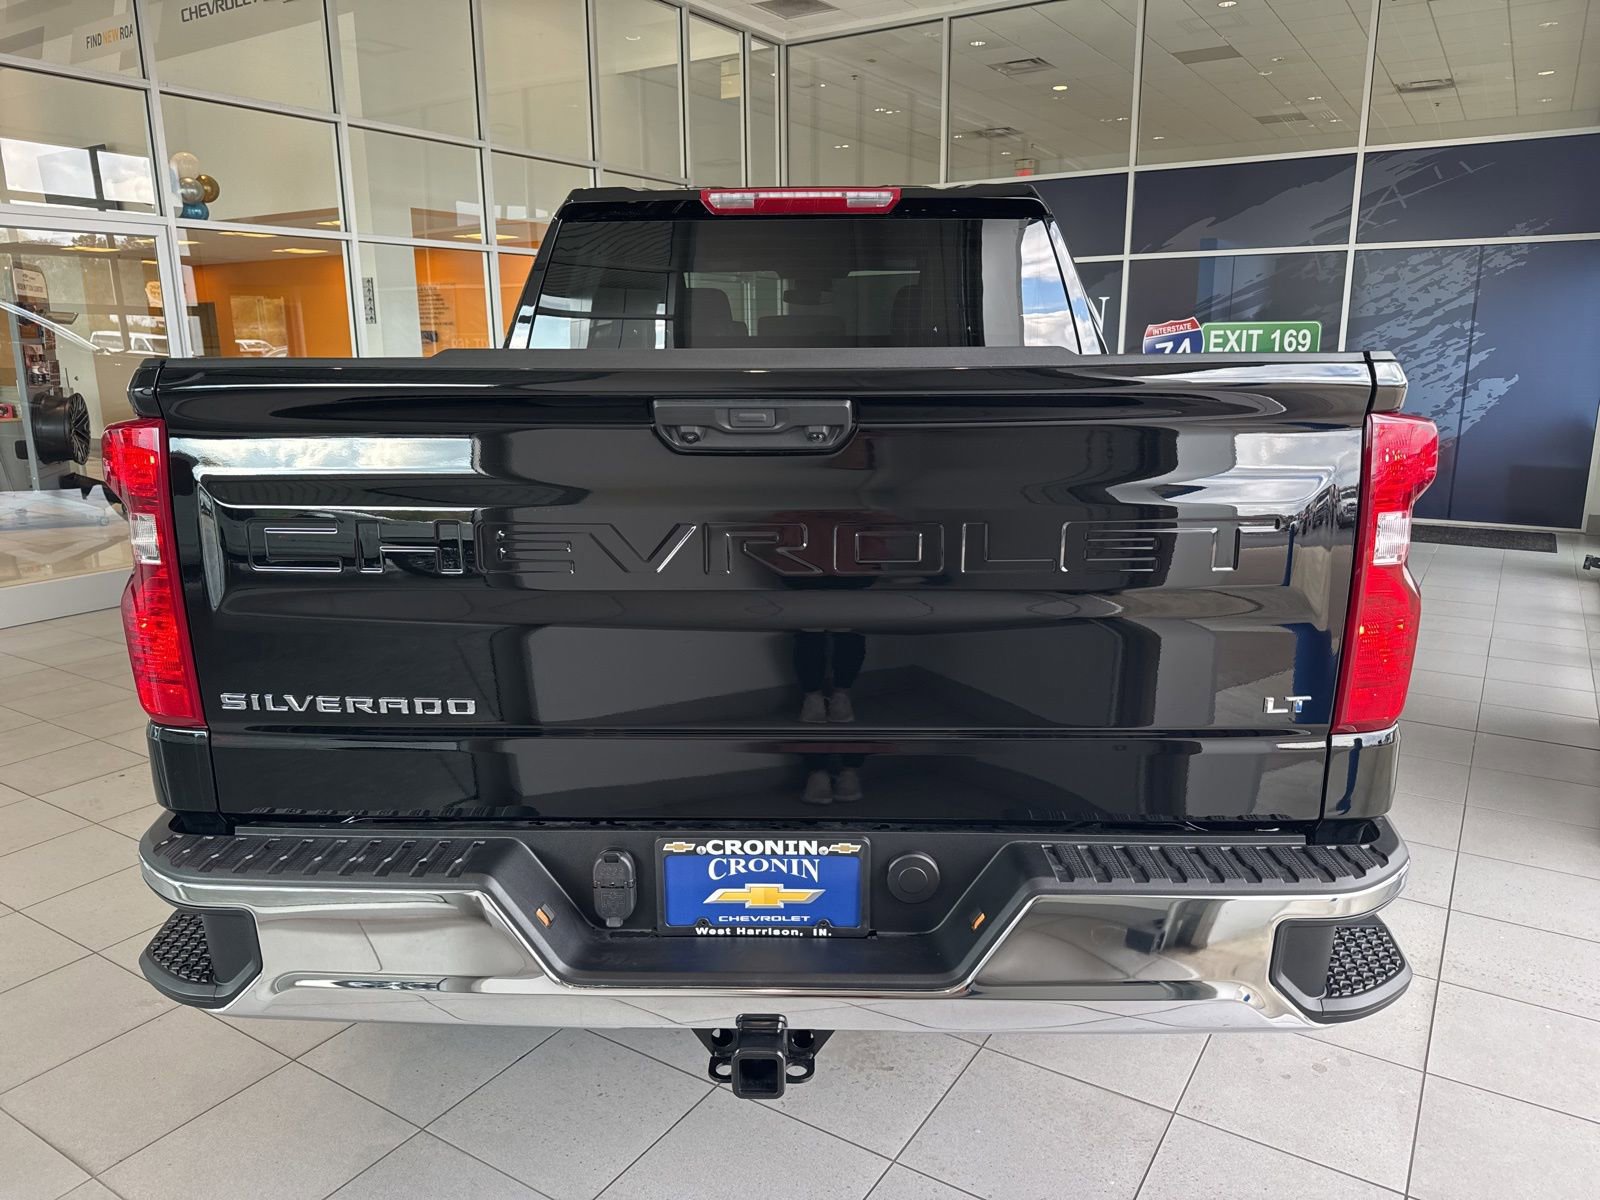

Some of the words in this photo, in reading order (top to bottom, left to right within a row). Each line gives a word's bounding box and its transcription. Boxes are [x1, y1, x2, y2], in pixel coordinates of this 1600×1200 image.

[180, 0, 257, 22] CHEVROL
[86, 33, 102, 49] FIND
[103, 28, 119, 45] NEW
[1152, 322, 1192, 335] INTERSTATE
[1209, 329, 1263, 352] EXIT
[1270, 329, 1312, 352] 169
[245, 516, 1282, 573] CHEVROLET
[220, 693, 477, 715] SILVERADO
[1263, 696, 1312, 713] LT
[706, 840, 818, 855] CRONIN
[708, 857, 820, 883] CRONIN
[695, 927, 731, 936] West
[737, 927, 804, 937] Harrison,
[813, 928, 832, 937] IN.
